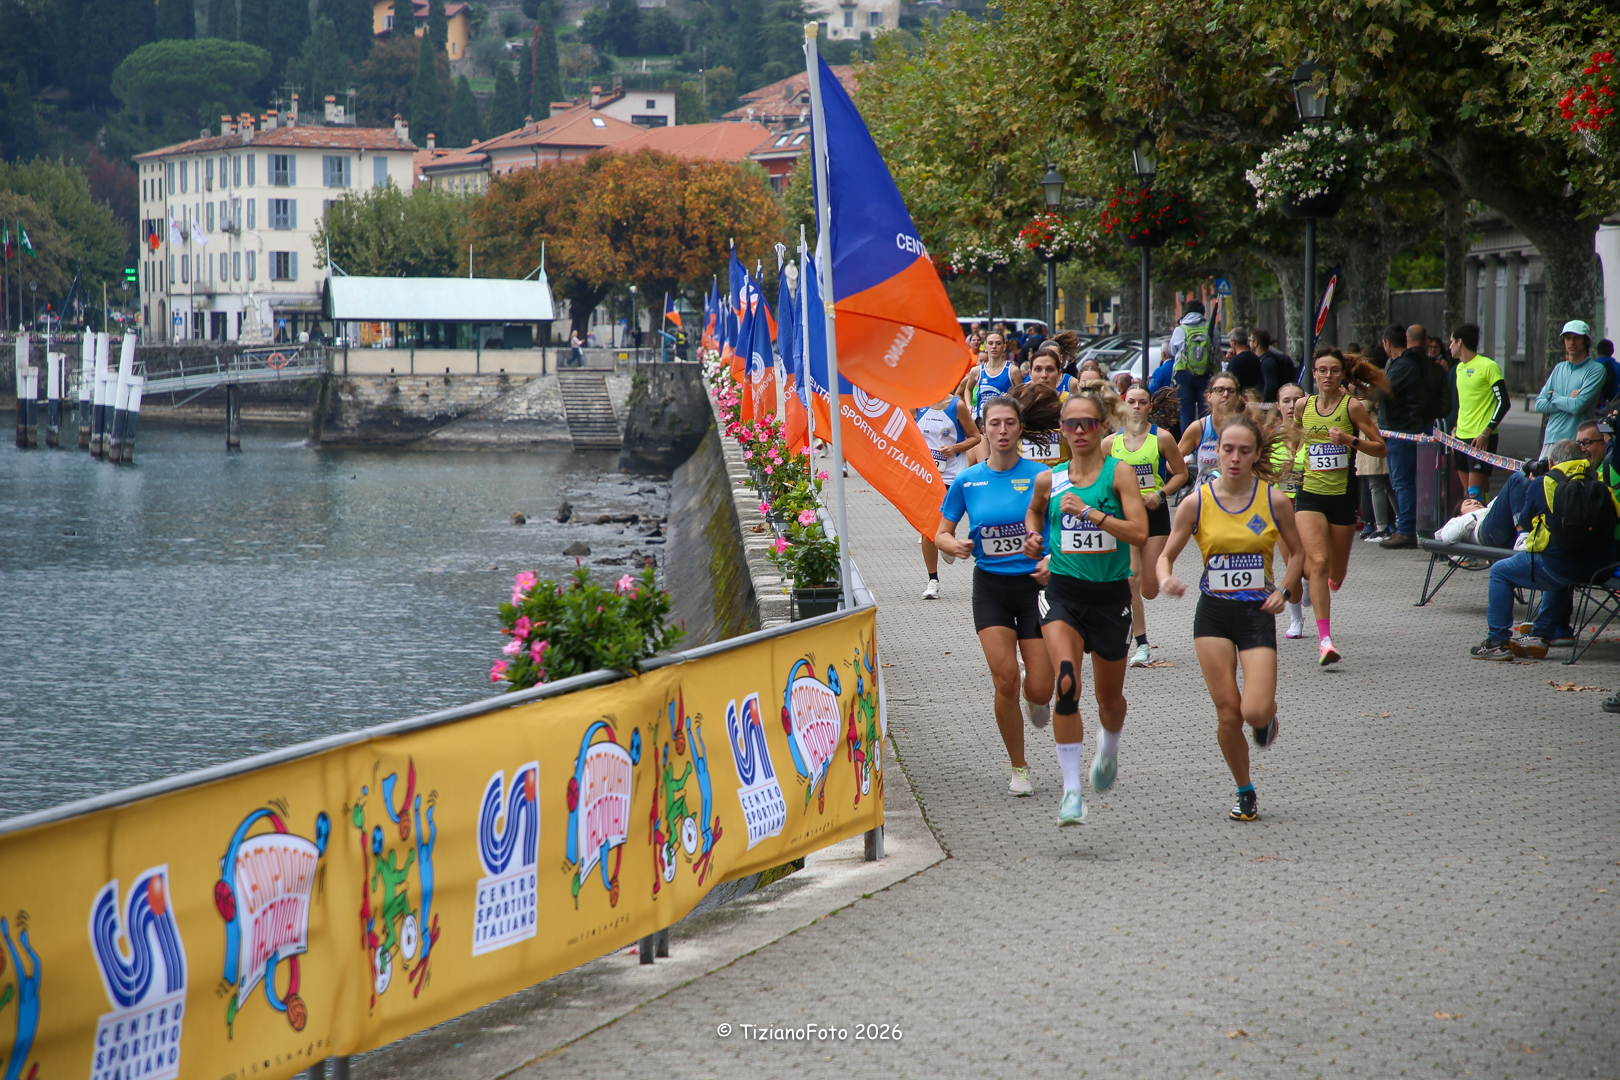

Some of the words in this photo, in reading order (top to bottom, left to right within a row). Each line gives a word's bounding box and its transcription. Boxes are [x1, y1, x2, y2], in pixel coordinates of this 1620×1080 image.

[896, 232, 932, 264] CENT
[810, 375, 840, 405] ENTR
[840, 404, 887, 450] SPORTIVO
[887, 446, 933, 484] ITALIANO
[1030, 445, 1052, 457] 146
[1317, 456, 1338, 468] 531
[993, 537, 1022, 553] 239
[1072, 533, 1103, 549] 541
[1220, 571, 1252, 588] 169
[742, 785, 782, 810] CENTRO
[746, 800, 785, 825] SPORTIVO
[750, 815, 786, 840] ITALIANO
[479, 874, 535, 906] CENTRO
[477, 892, 535, 924] SPORTIVO
[476, 910, 536, 942] ITALIANO
[99, 1002, 182, 1047] CENTRO
[97, 1024, 179, 1069] SPORTIVO
